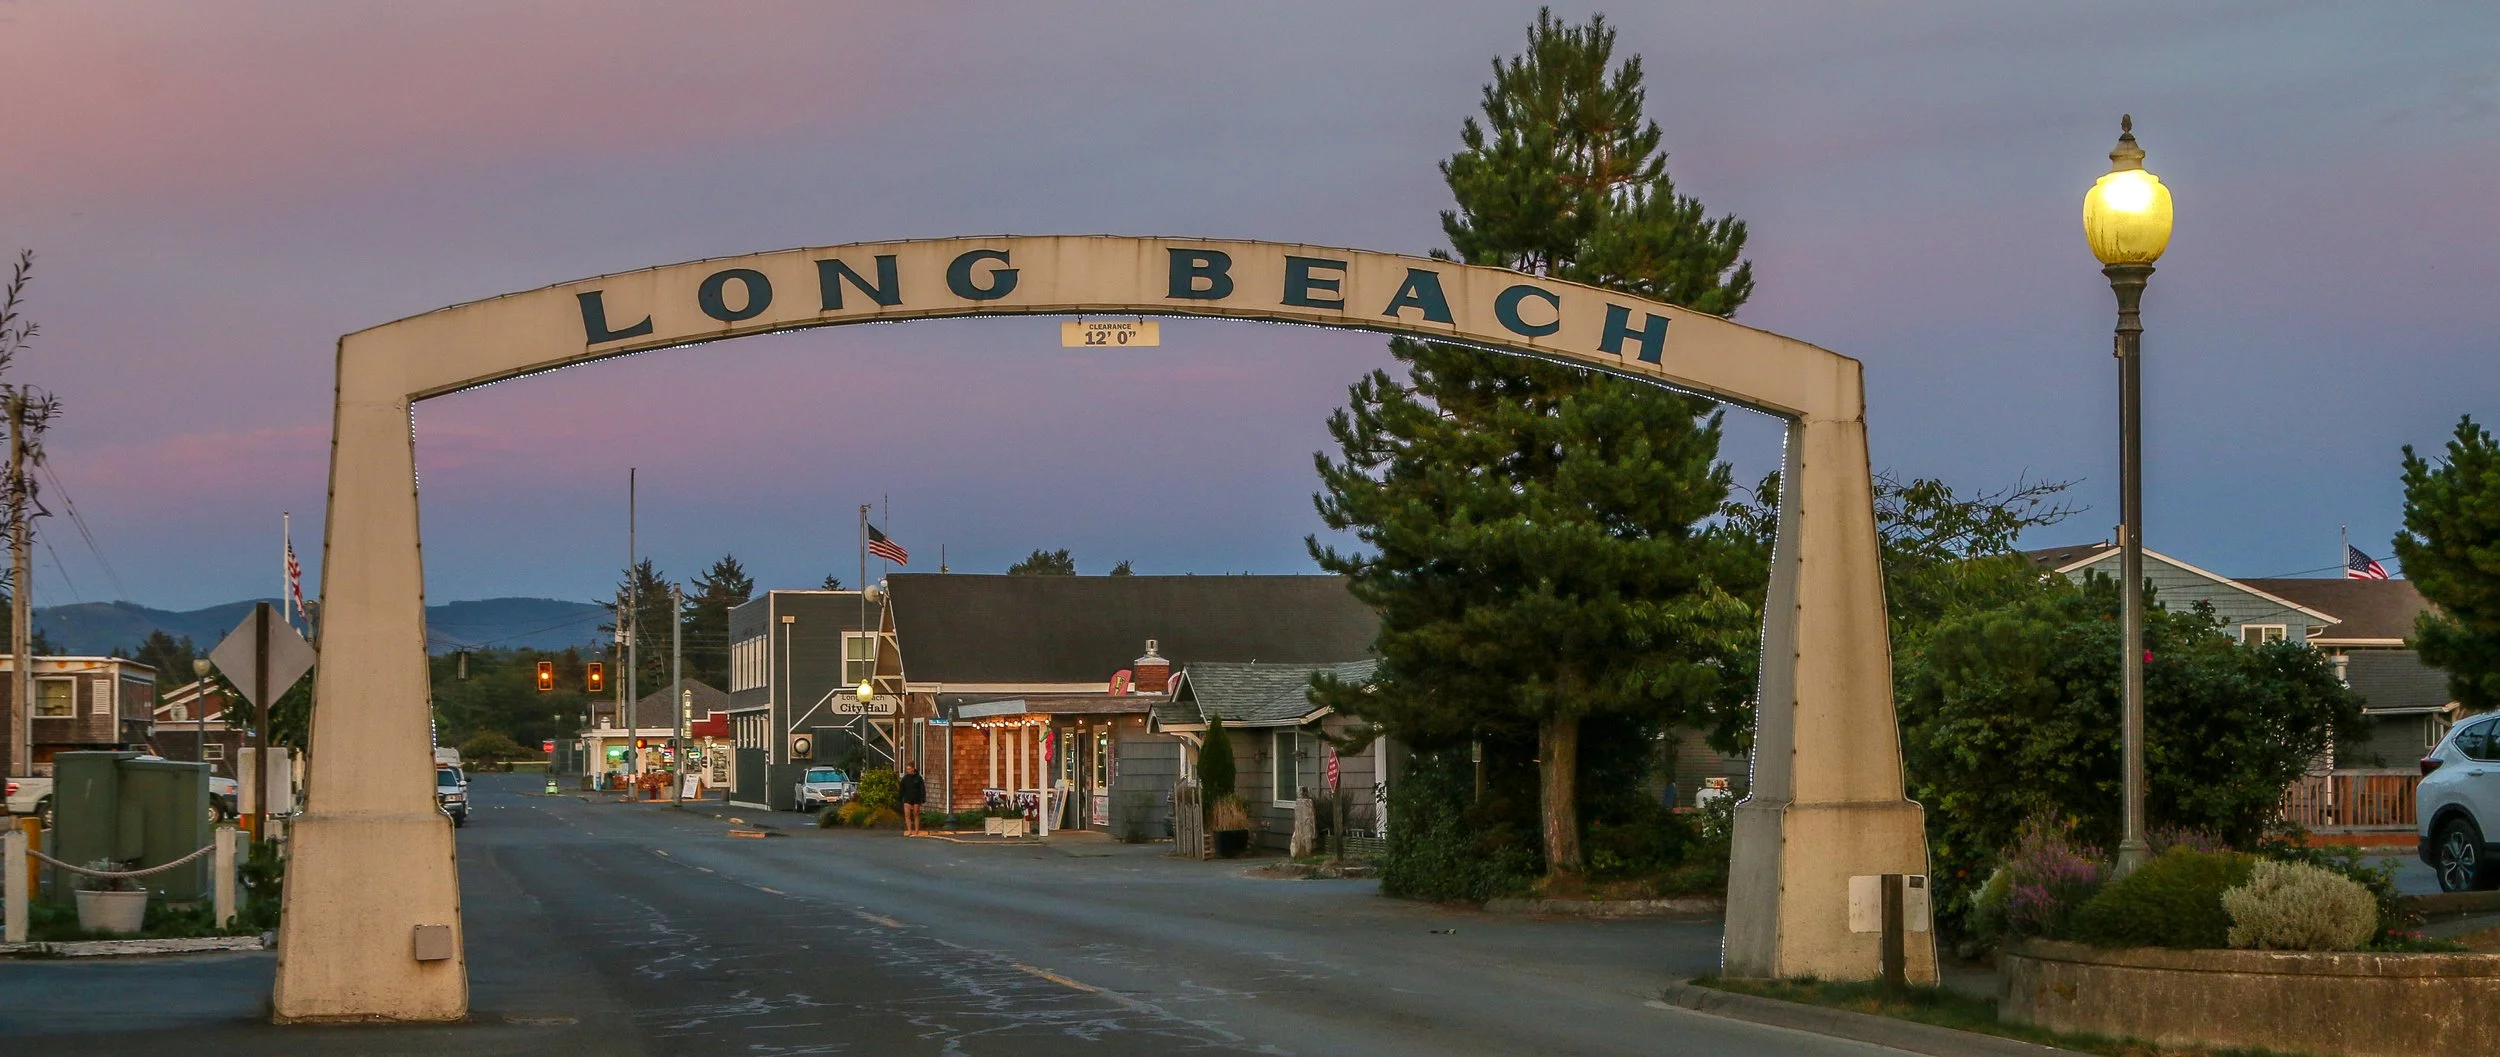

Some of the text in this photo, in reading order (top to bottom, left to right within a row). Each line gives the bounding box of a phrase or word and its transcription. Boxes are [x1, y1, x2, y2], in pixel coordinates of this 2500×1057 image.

[576, 247, 1672, 365] LONG BEACH
[840, 703, 888, 714] City Hall
